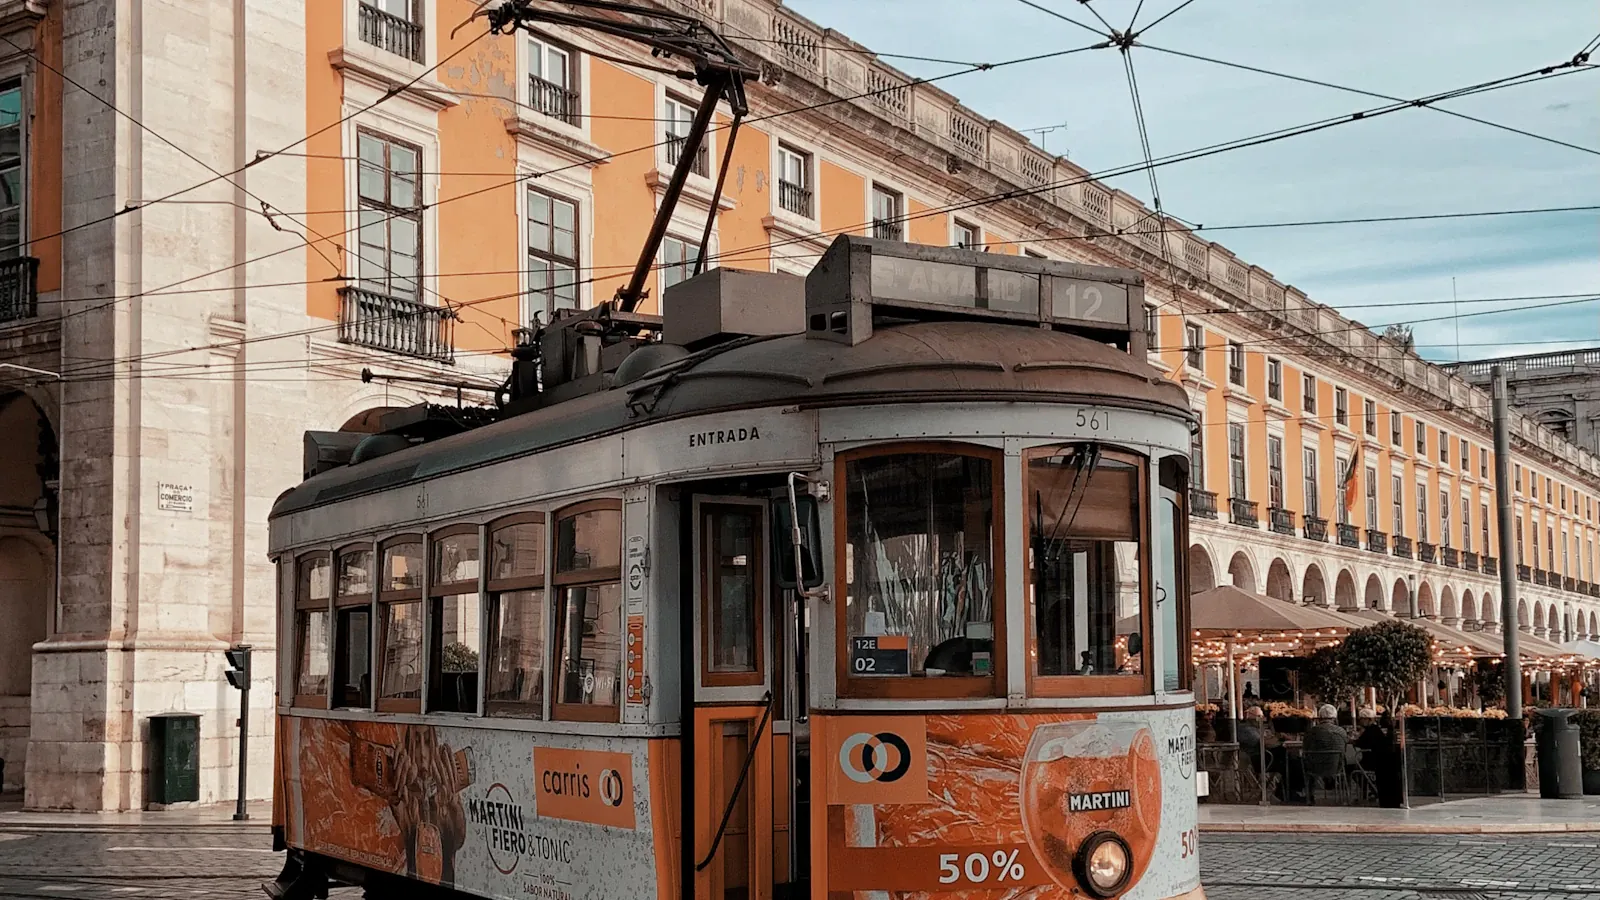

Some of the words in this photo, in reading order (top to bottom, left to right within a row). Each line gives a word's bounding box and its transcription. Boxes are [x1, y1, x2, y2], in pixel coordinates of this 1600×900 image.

[1065, 284, 1102, 319] 12
[1076, 408, 1109, 431] 561
[689, 426, 760, 448] ENTRADA
[165, 484, 188, 492] PRAÇA
[855, 640, 876, 650] 12E
[855, 657, 876, 671] 02
[542, 763, 590, 798] carris
[1070, 791, 1130, 811] MARTINI
[469, 798, 525, 831] MARTINI
[492, 828, 526, 855] FIERO
[938, 849, 1025, 884] 50%
[540, 873, 555, 886] 100%
